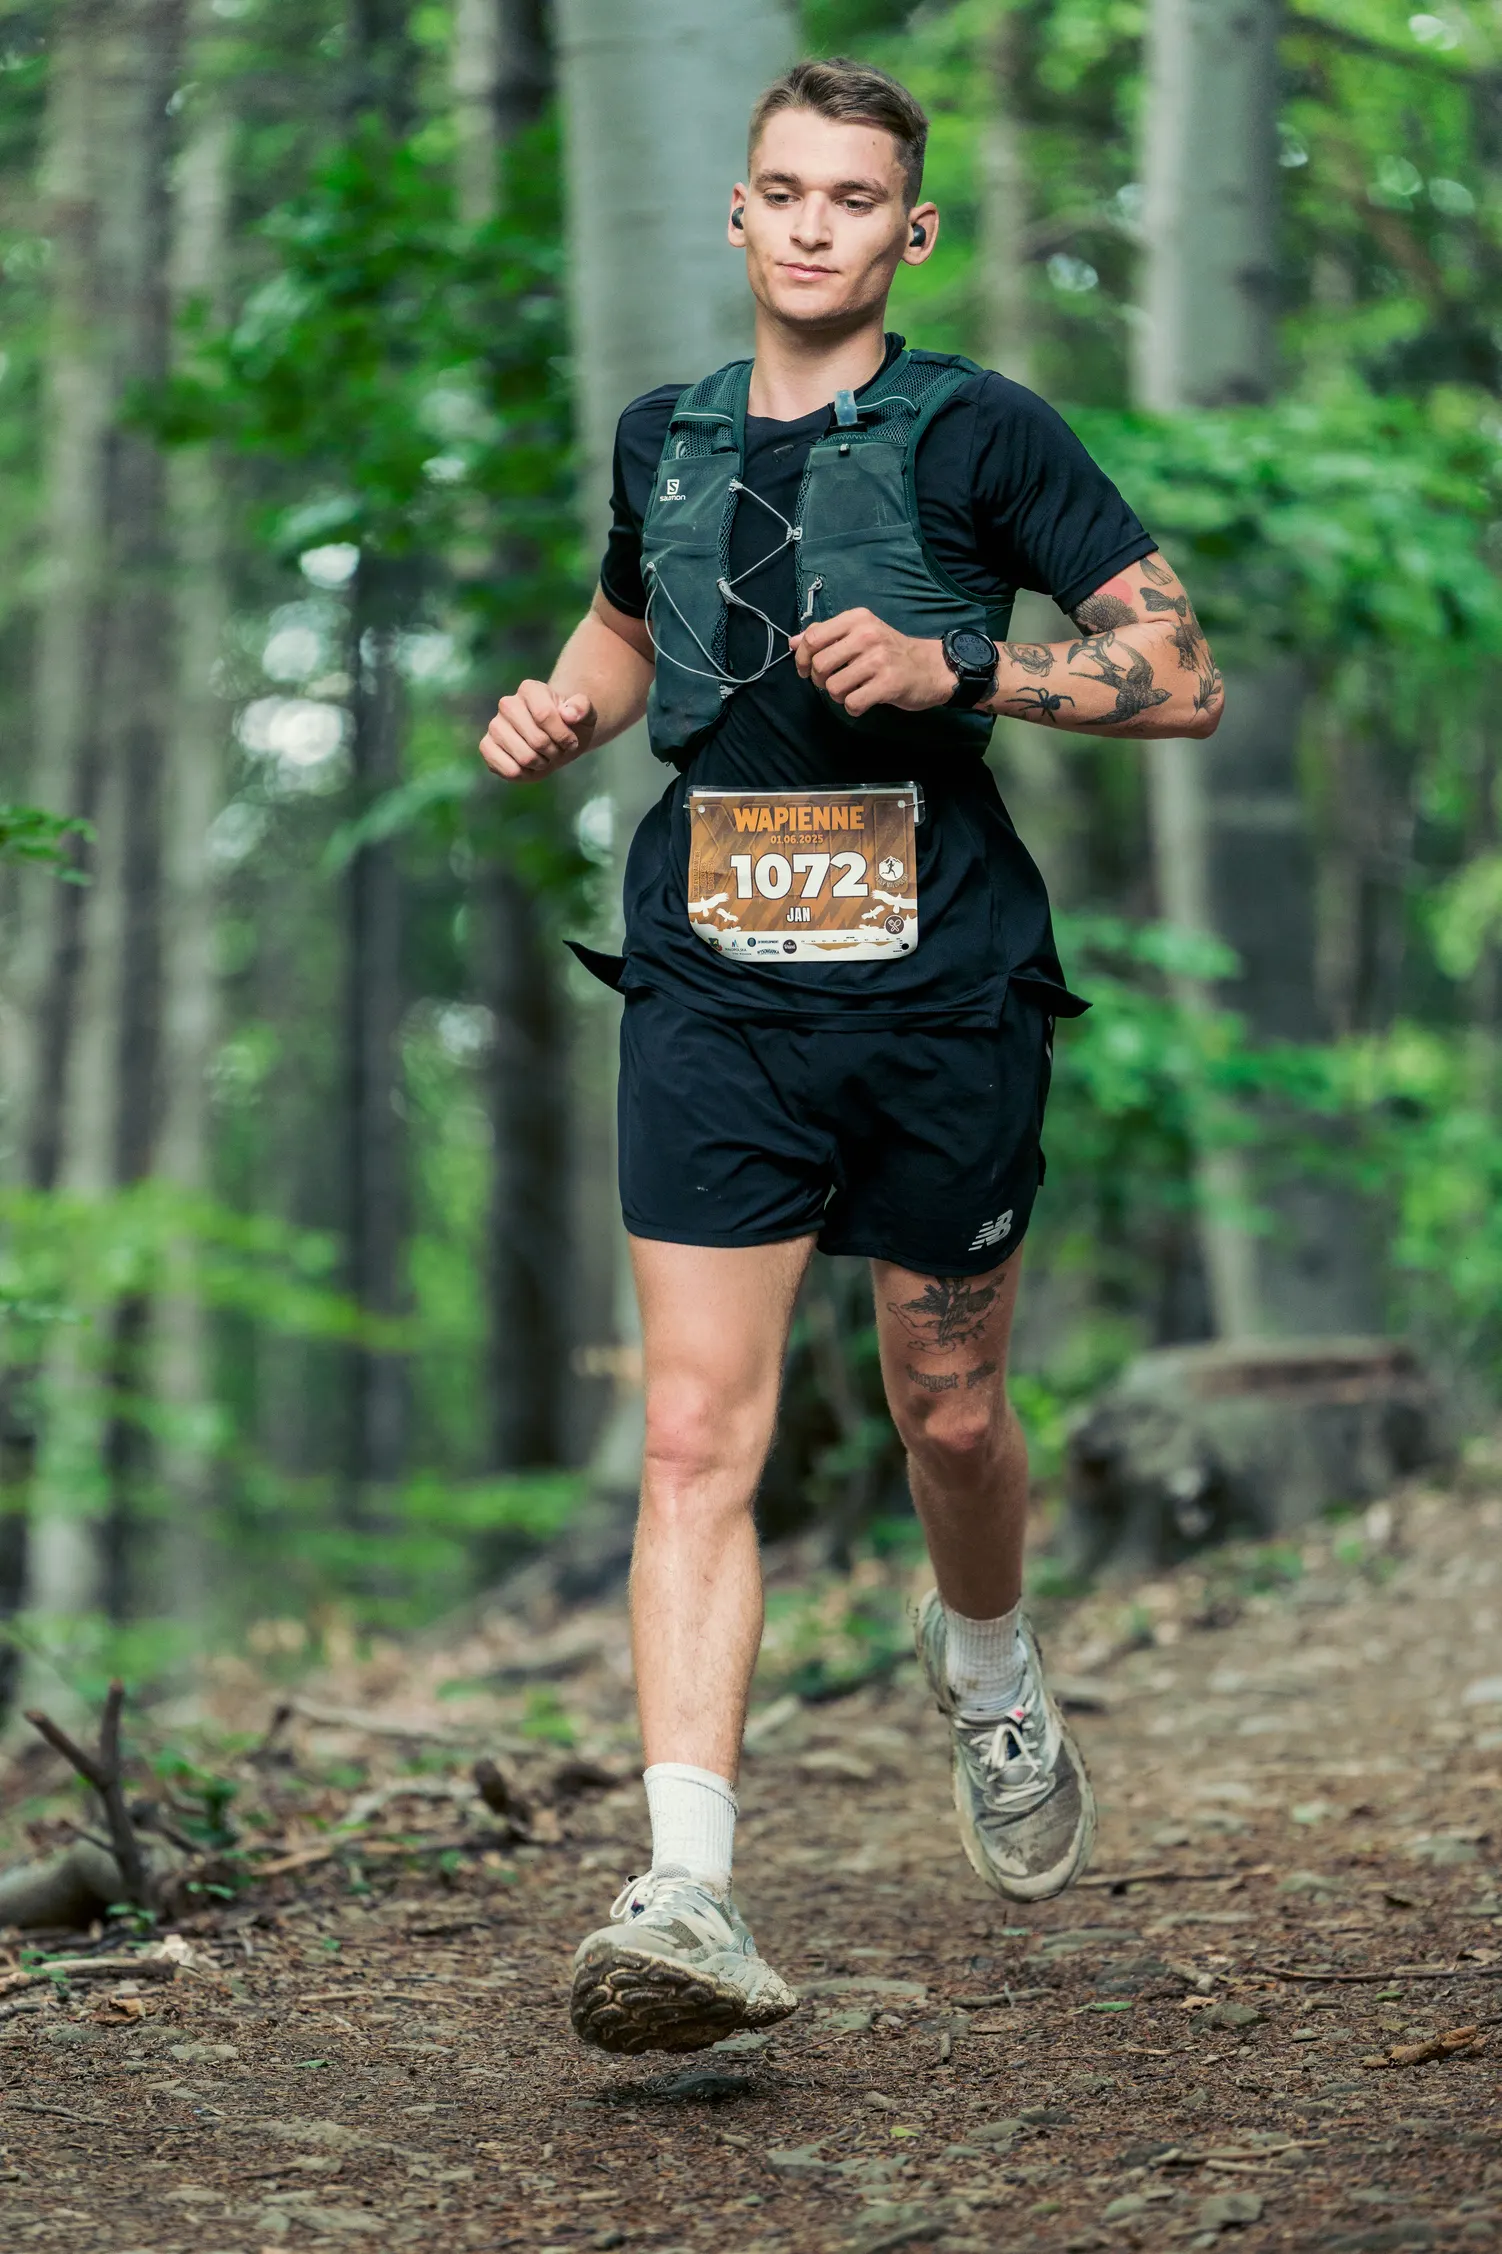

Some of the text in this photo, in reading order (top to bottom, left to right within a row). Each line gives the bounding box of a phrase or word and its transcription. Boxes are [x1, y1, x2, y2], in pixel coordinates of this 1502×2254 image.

[733, 806, 865, 832] WAPIENNE
[770, 834, 824, 844] 01.06.2025
[730, 851, 869, 900] 1072
[786, 907, 811, 923] JAN
